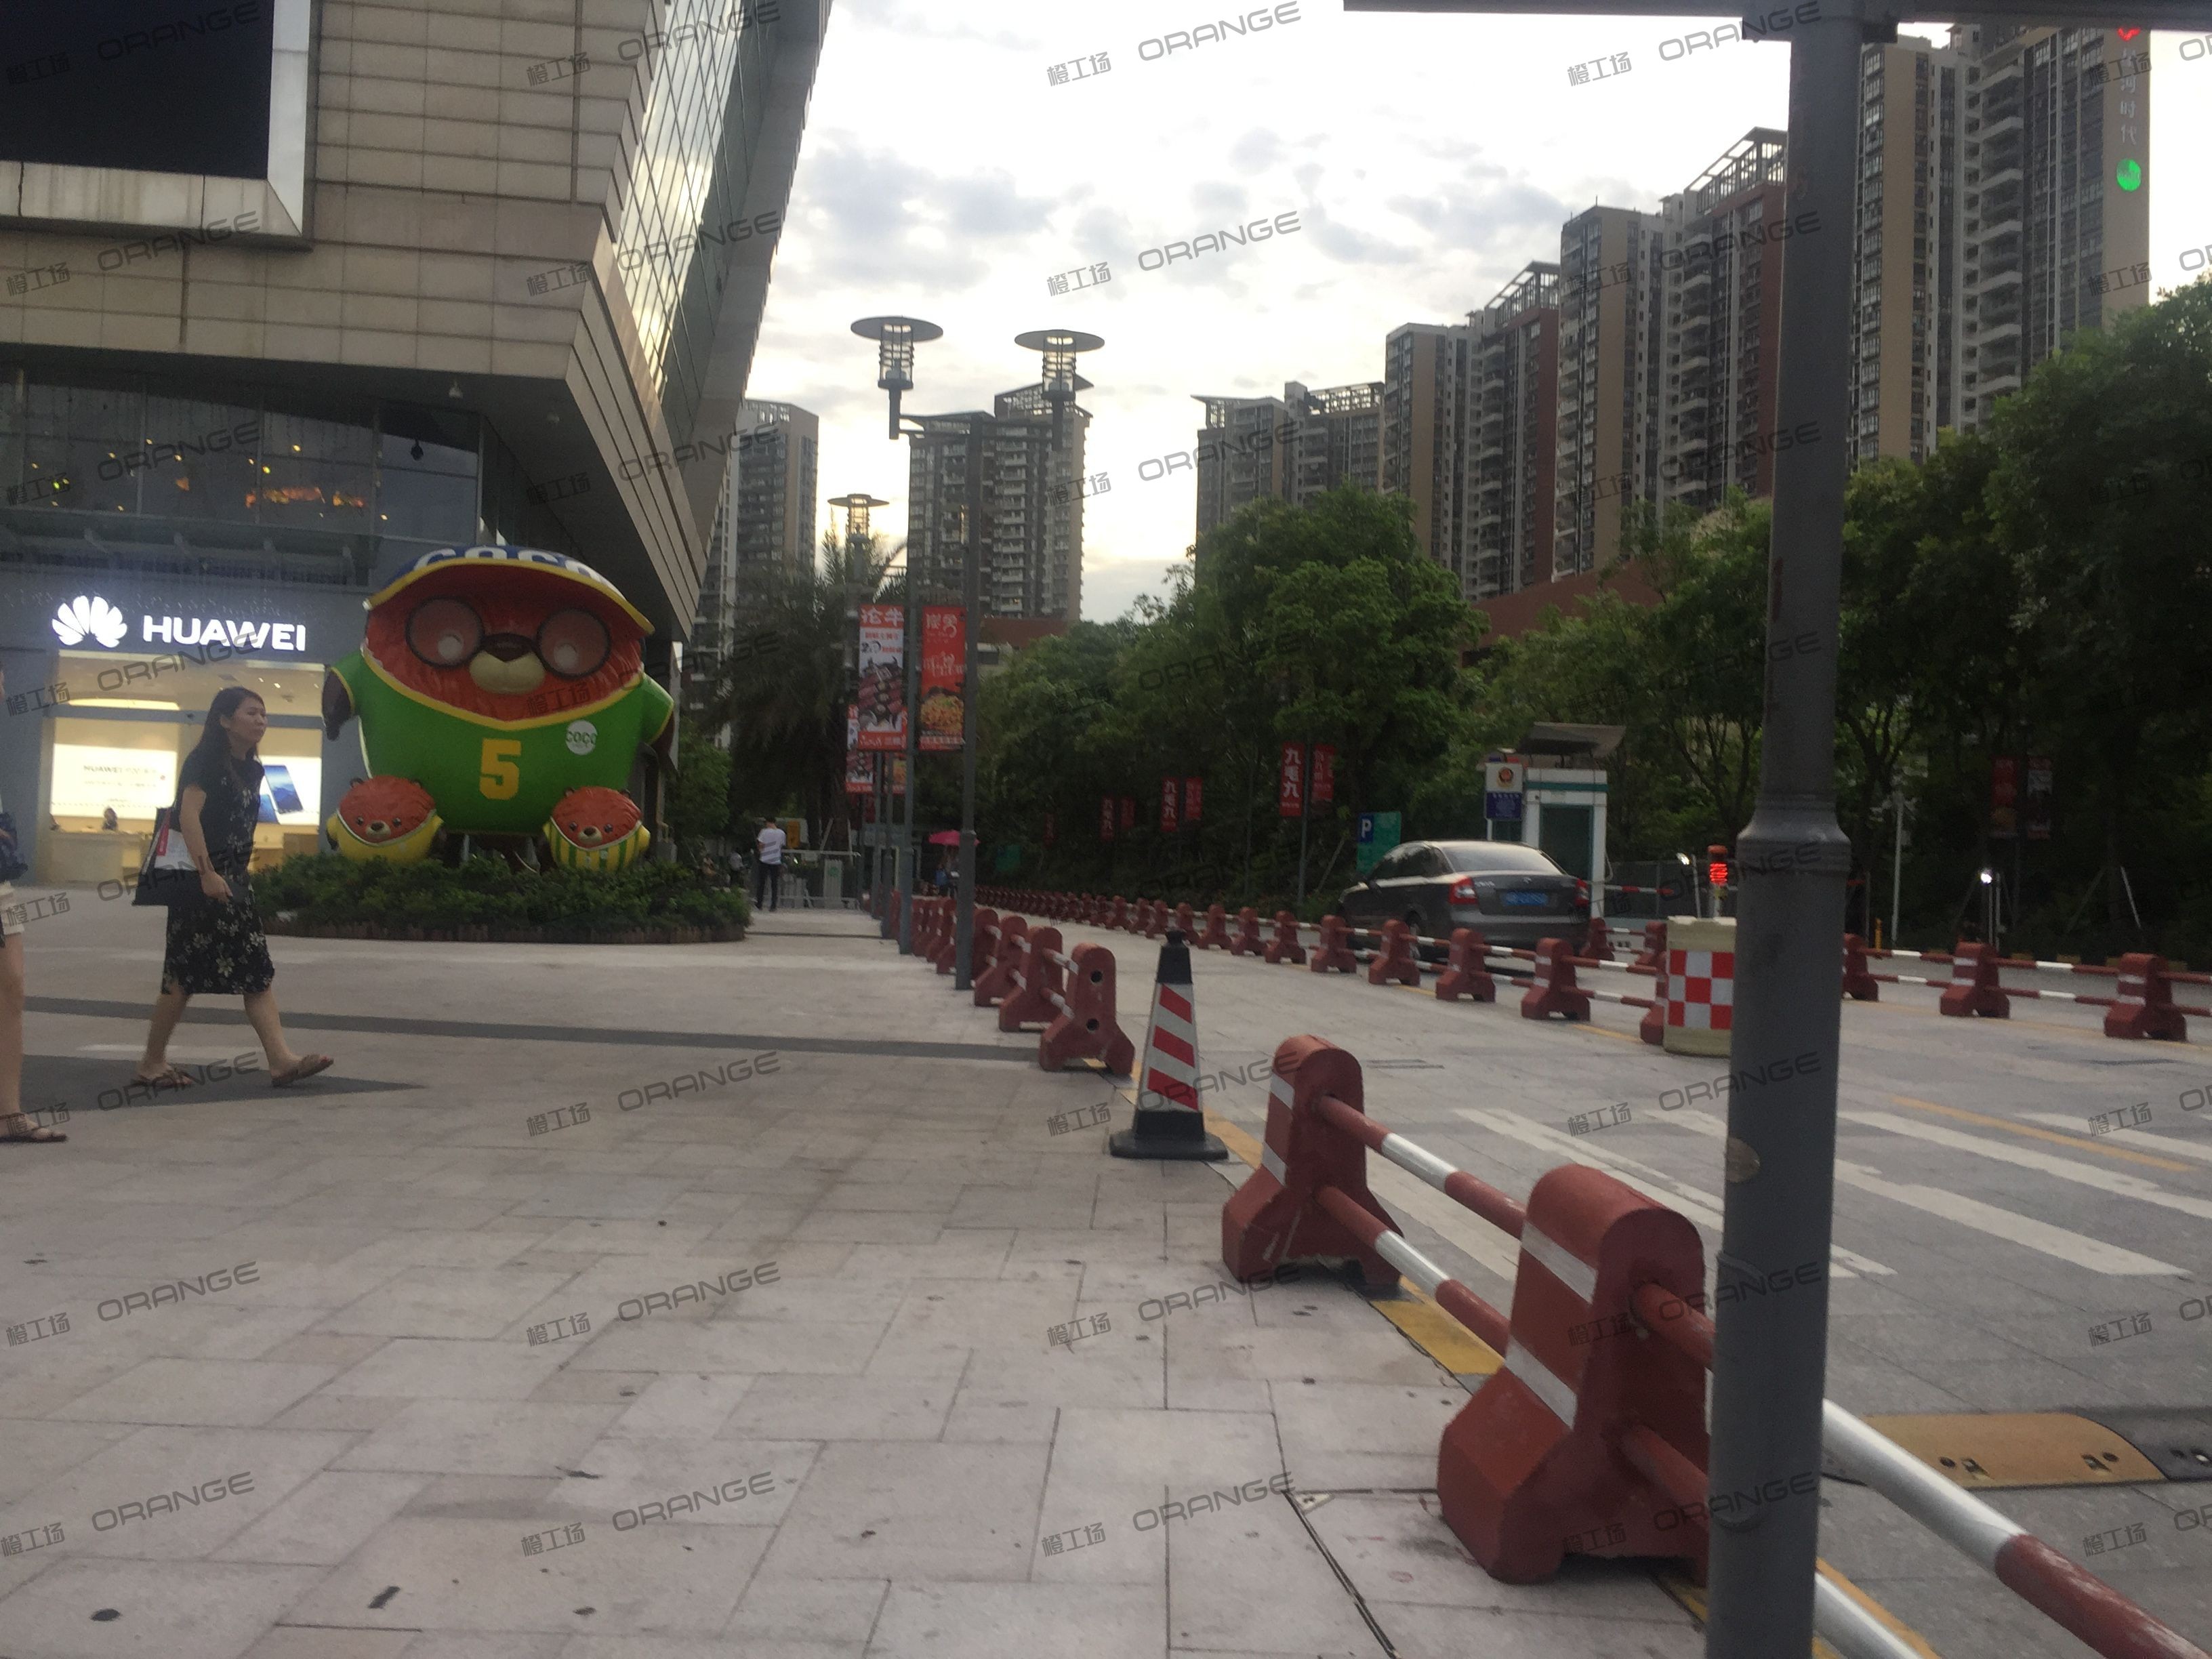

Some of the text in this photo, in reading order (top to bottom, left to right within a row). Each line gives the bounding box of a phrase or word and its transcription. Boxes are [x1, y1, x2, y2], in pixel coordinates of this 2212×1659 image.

[143, 615, 306, 652] HUAWEI
[478, 738, 522, 800] 5
[1361, 818, 1372, 838] P
